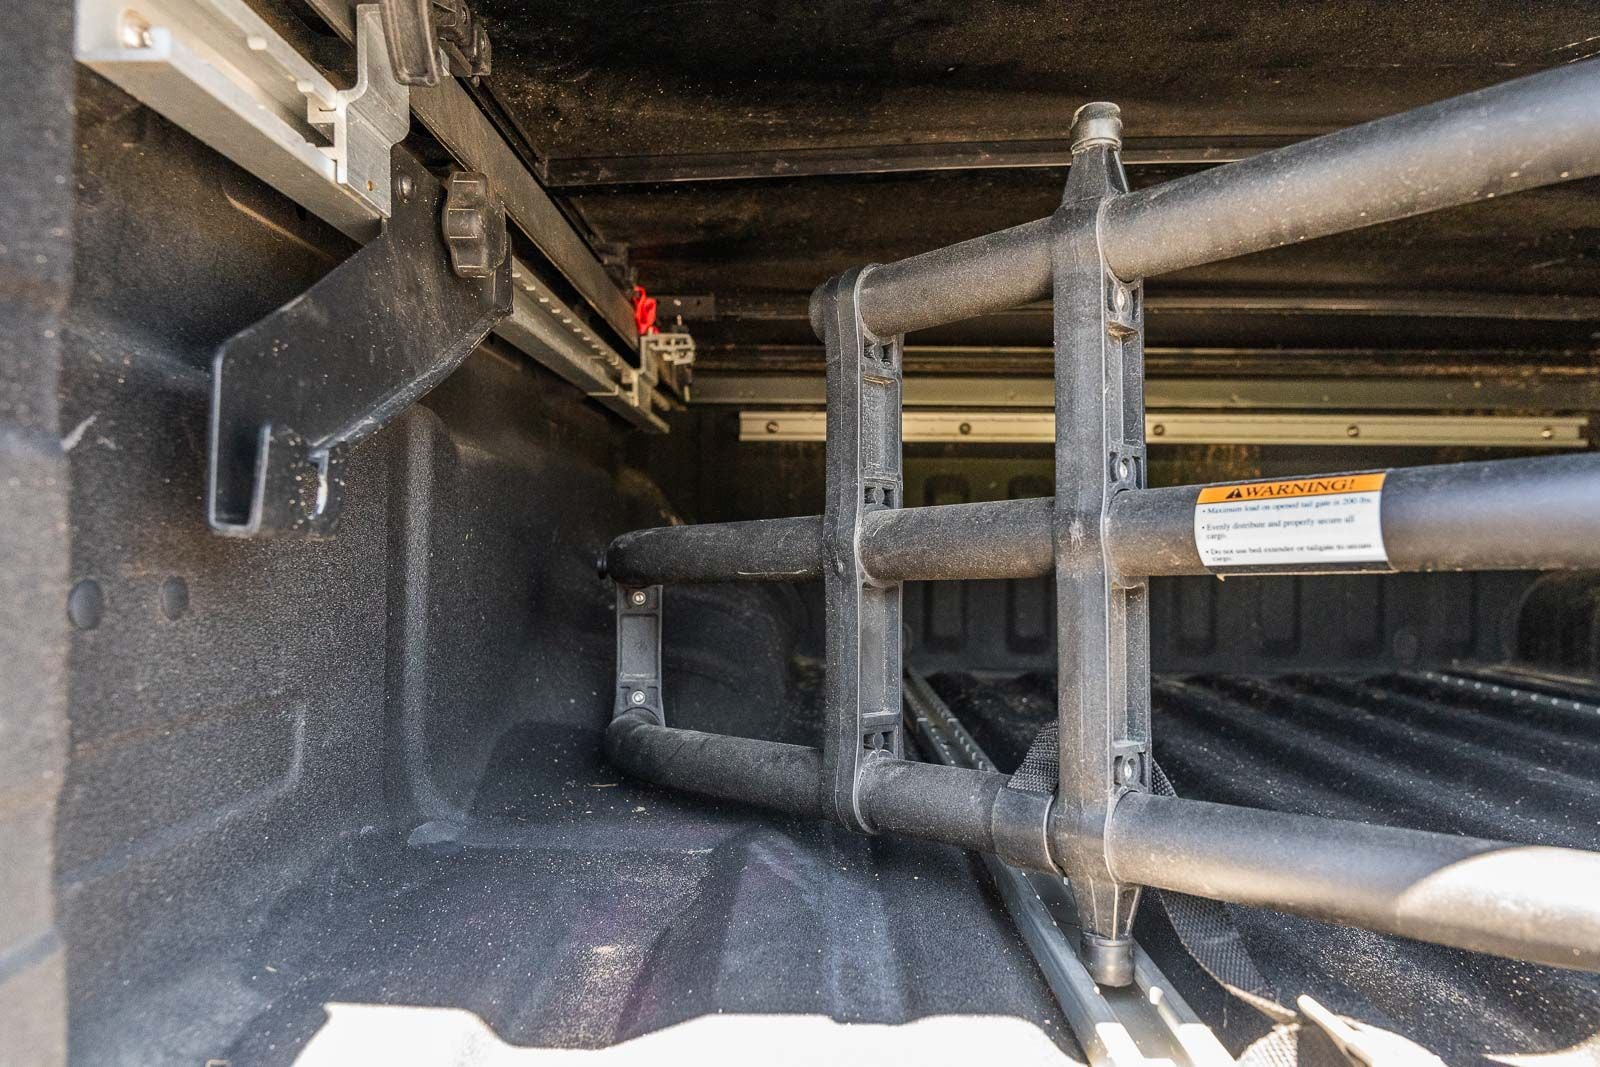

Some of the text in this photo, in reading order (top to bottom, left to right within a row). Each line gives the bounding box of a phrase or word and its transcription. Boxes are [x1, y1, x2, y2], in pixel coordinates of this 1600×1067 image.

[1246, 479, 1355, 496] WARNING!
[1207, 523, 1230, 531] Evenly
[1232, 521, 1265, 529] distribute
[1283, 518, 1314, 528] properly
[1344, 515, 1355, 523] all
